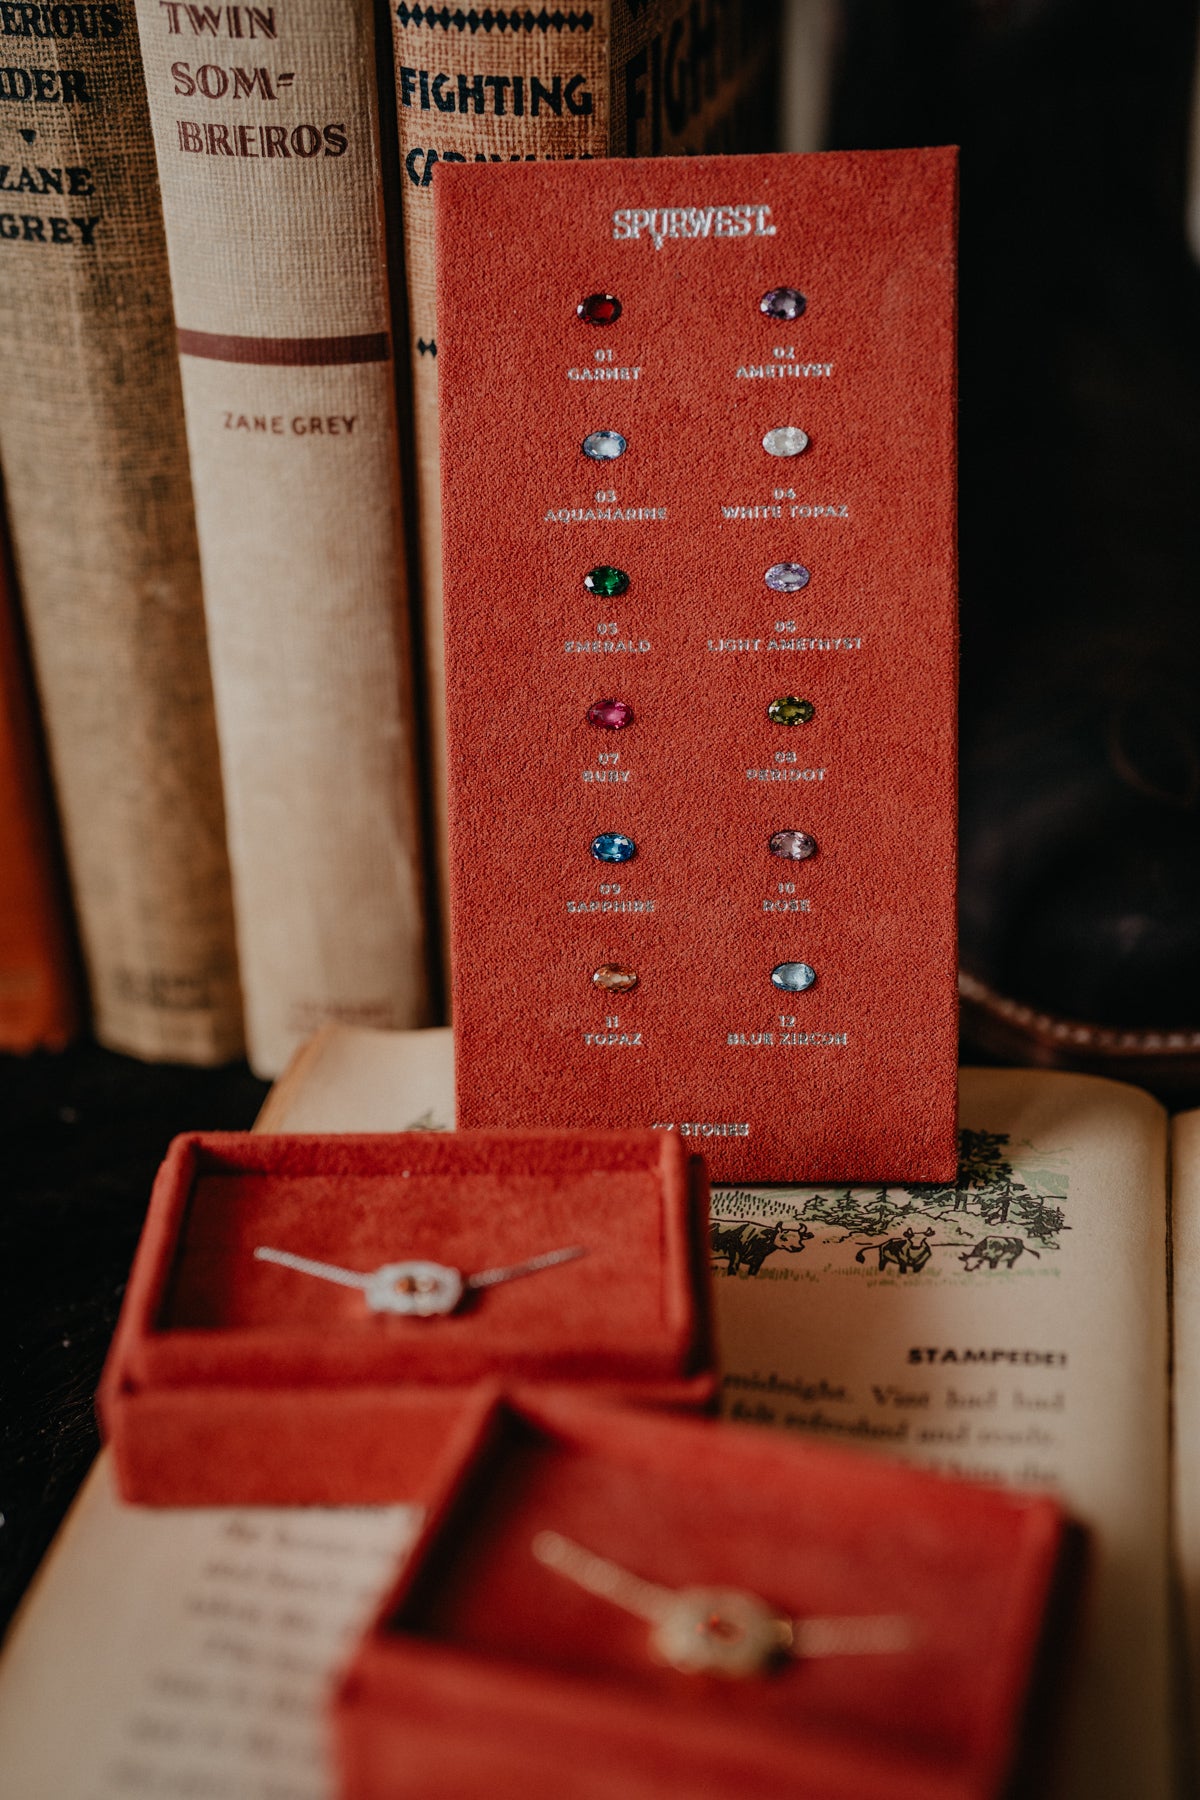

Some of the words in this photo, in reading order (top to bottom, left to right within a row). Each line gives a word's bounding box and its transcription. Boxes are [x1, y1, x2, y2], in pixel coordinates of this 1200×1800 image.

[160, 1, 278, 40] TWIN
[400, 66, 593, 116] FIGHTING
[176, 120, 349, 158] BREROS
[0, 214, 100, 245] GREY
[594, 349, 613, 362] 01
[772, 346, 796, 360] 02
[567, 366, 642, 382] GARNET
[735, 363, 833, 380] AMETHYST
[223, 412, 284, 434] ZANE
[291, 414, 358, 436] GREY
[594, 490, 617, 503] 03
[773, 487, 797, 500] 04
[543, 507, 668, 524] AQUAMARINE
[720, 505, 783, 520] WHITE
[790, 504, 850, 518] TOPAZ
[596, 622, 618, 635] 05
[774, 620, 797, 633] 06
[564, 640, 651, 653] EMERALD
[707, 638, 761, 652] LIGHT
[766, 637, 863, 651] AMETHYST
[598, 752, 620, 766] 07
[774, 751, 798, 764] 08
[581, 770, 630, 783] RUBY
[746, 768, 827, 781] PERIDOT
[599, 883, 622, 896] 09
[778, 882, 796, 895] 10
[566, 900, 656, 914] SAPPHIRE
[762, 899, 811, 912] ROSE
[605, 1015, 619, 1029] 11
[584, 1033, 643, 1046] TOPAZ
[727, 1032, 775, 1046] BLUE
[779, 1032, 848, 1046] ZIRCON
[680, 1122, 750, 1137] STONES
